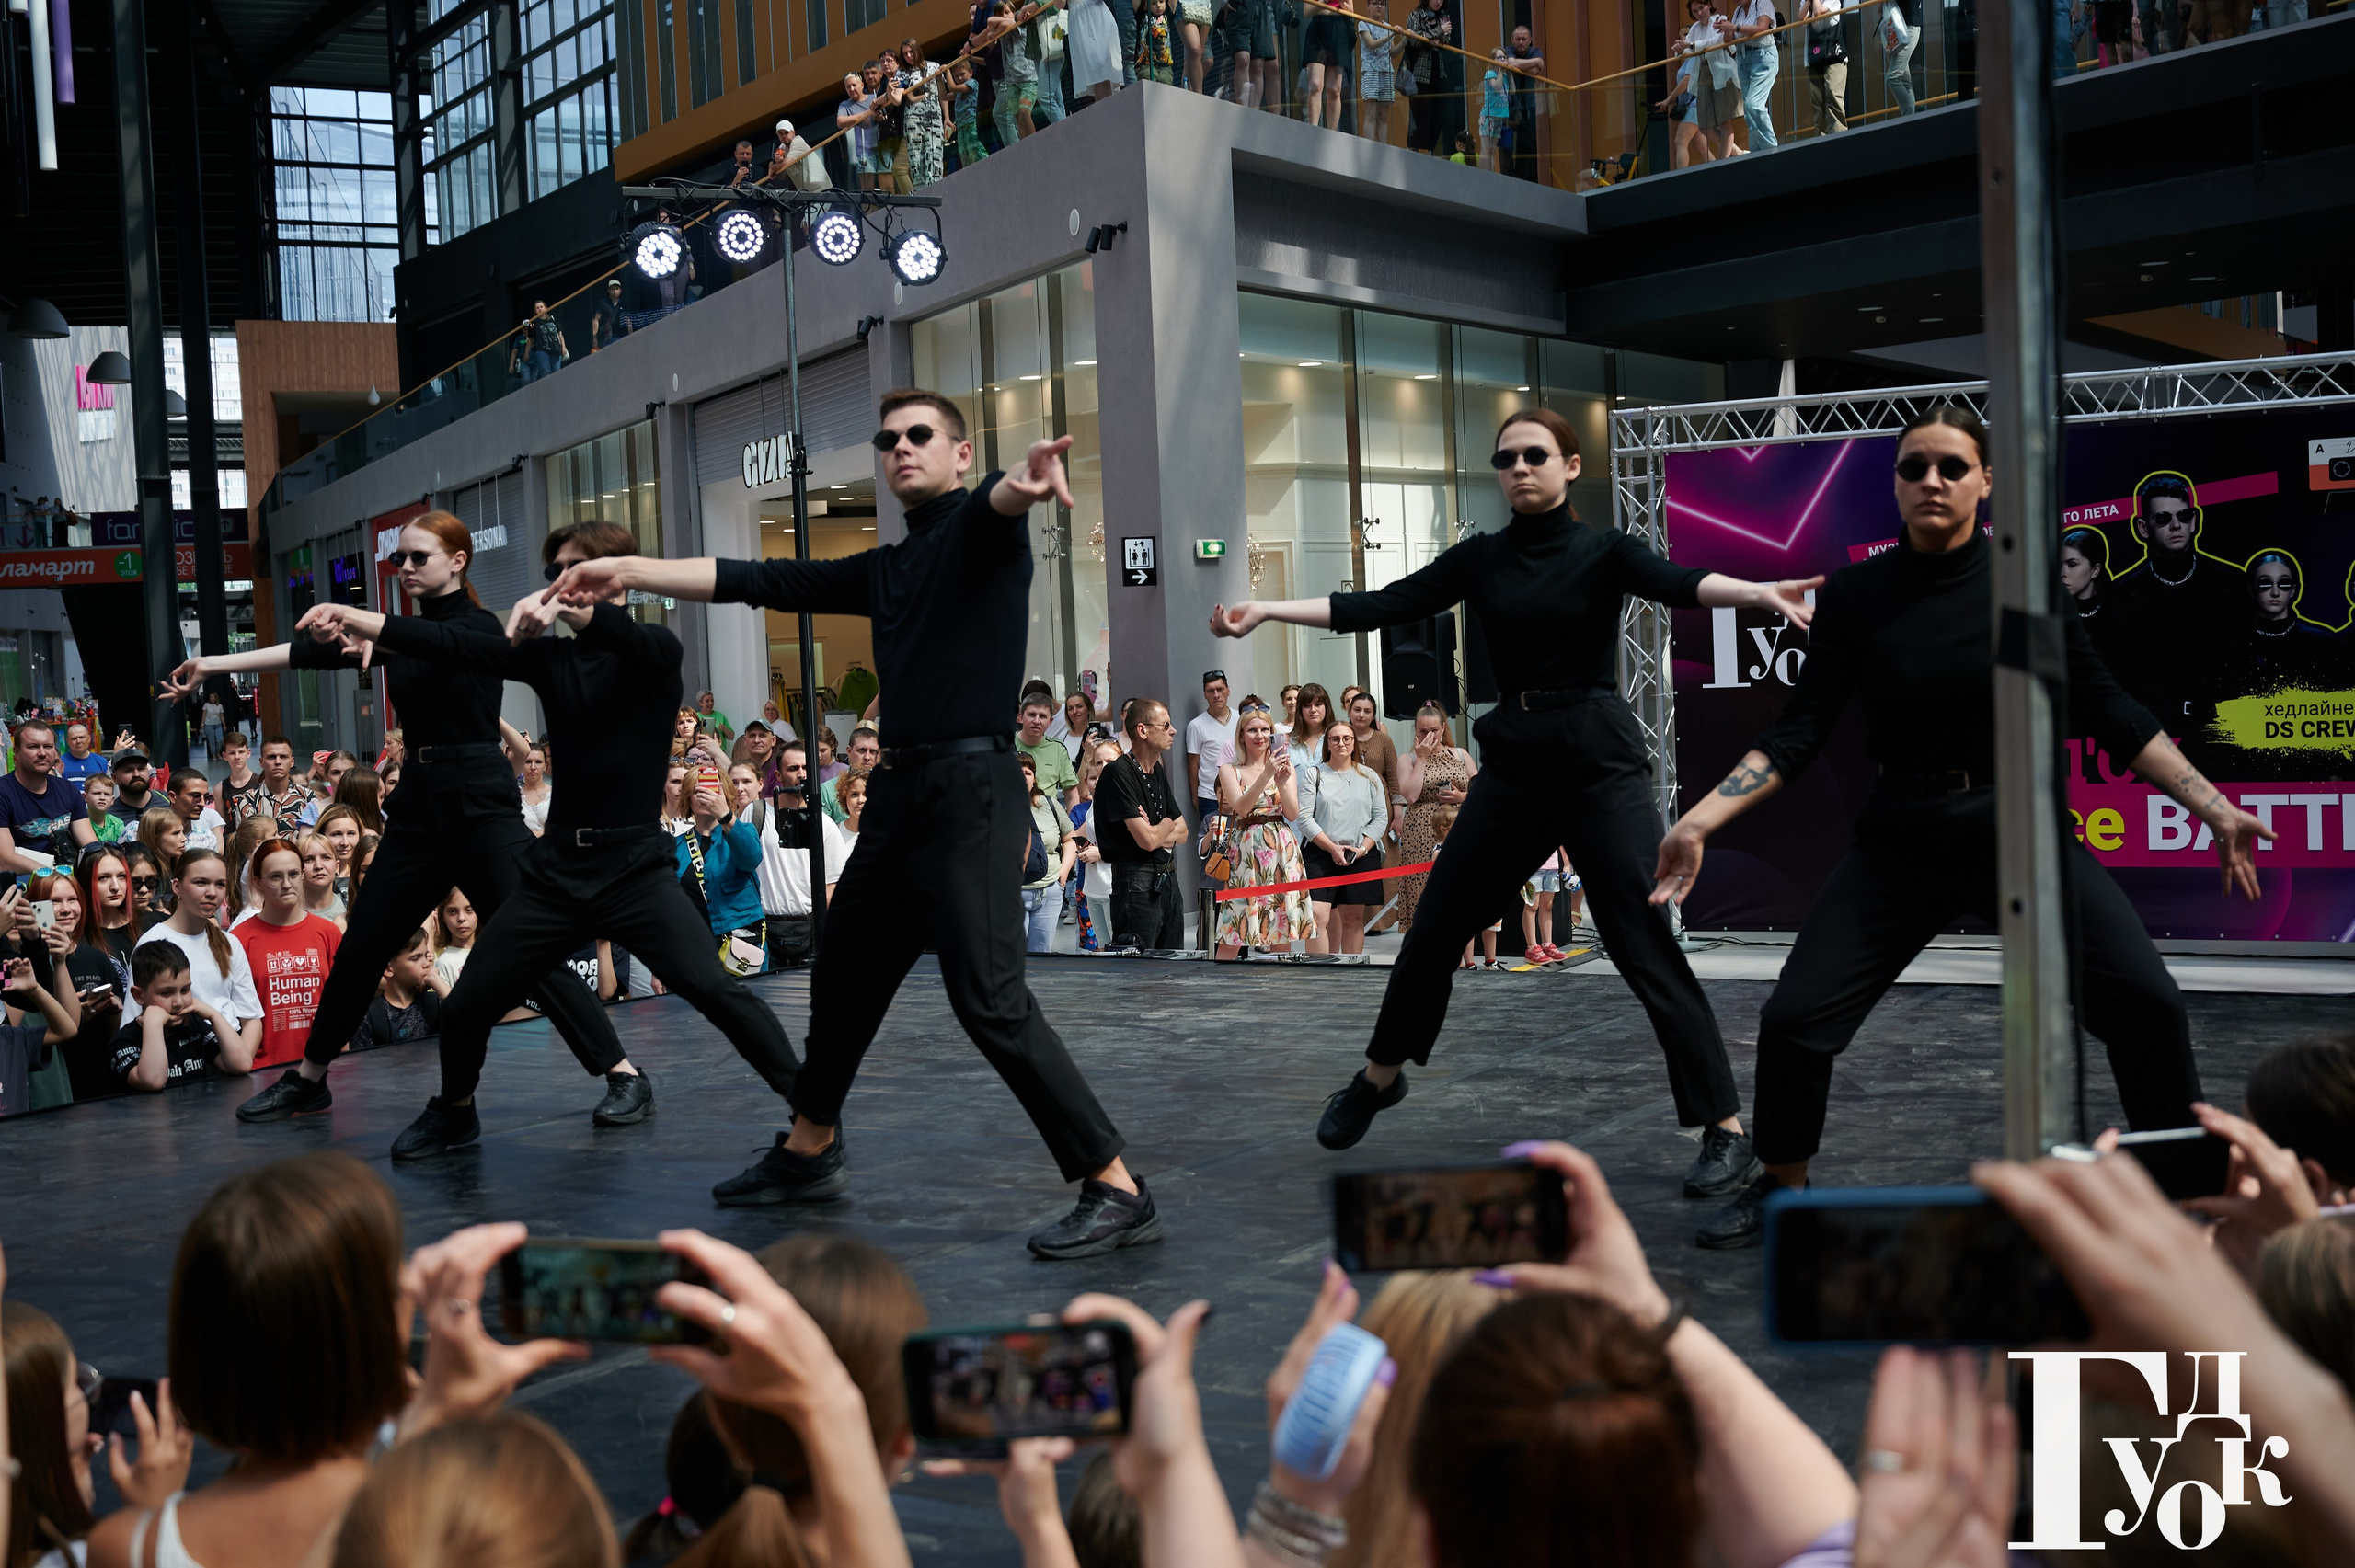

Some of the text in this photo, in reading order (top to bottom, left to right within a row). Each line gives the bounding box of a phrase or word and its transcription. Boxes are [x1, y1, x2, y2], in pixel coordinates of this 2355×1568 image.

[2315, 443, 2325, 453] A
[2084, 505, 2119, 521] ЛЕТА
[2265, 721, 2294, 738] DS
[269, 976, 320, 991] Human
